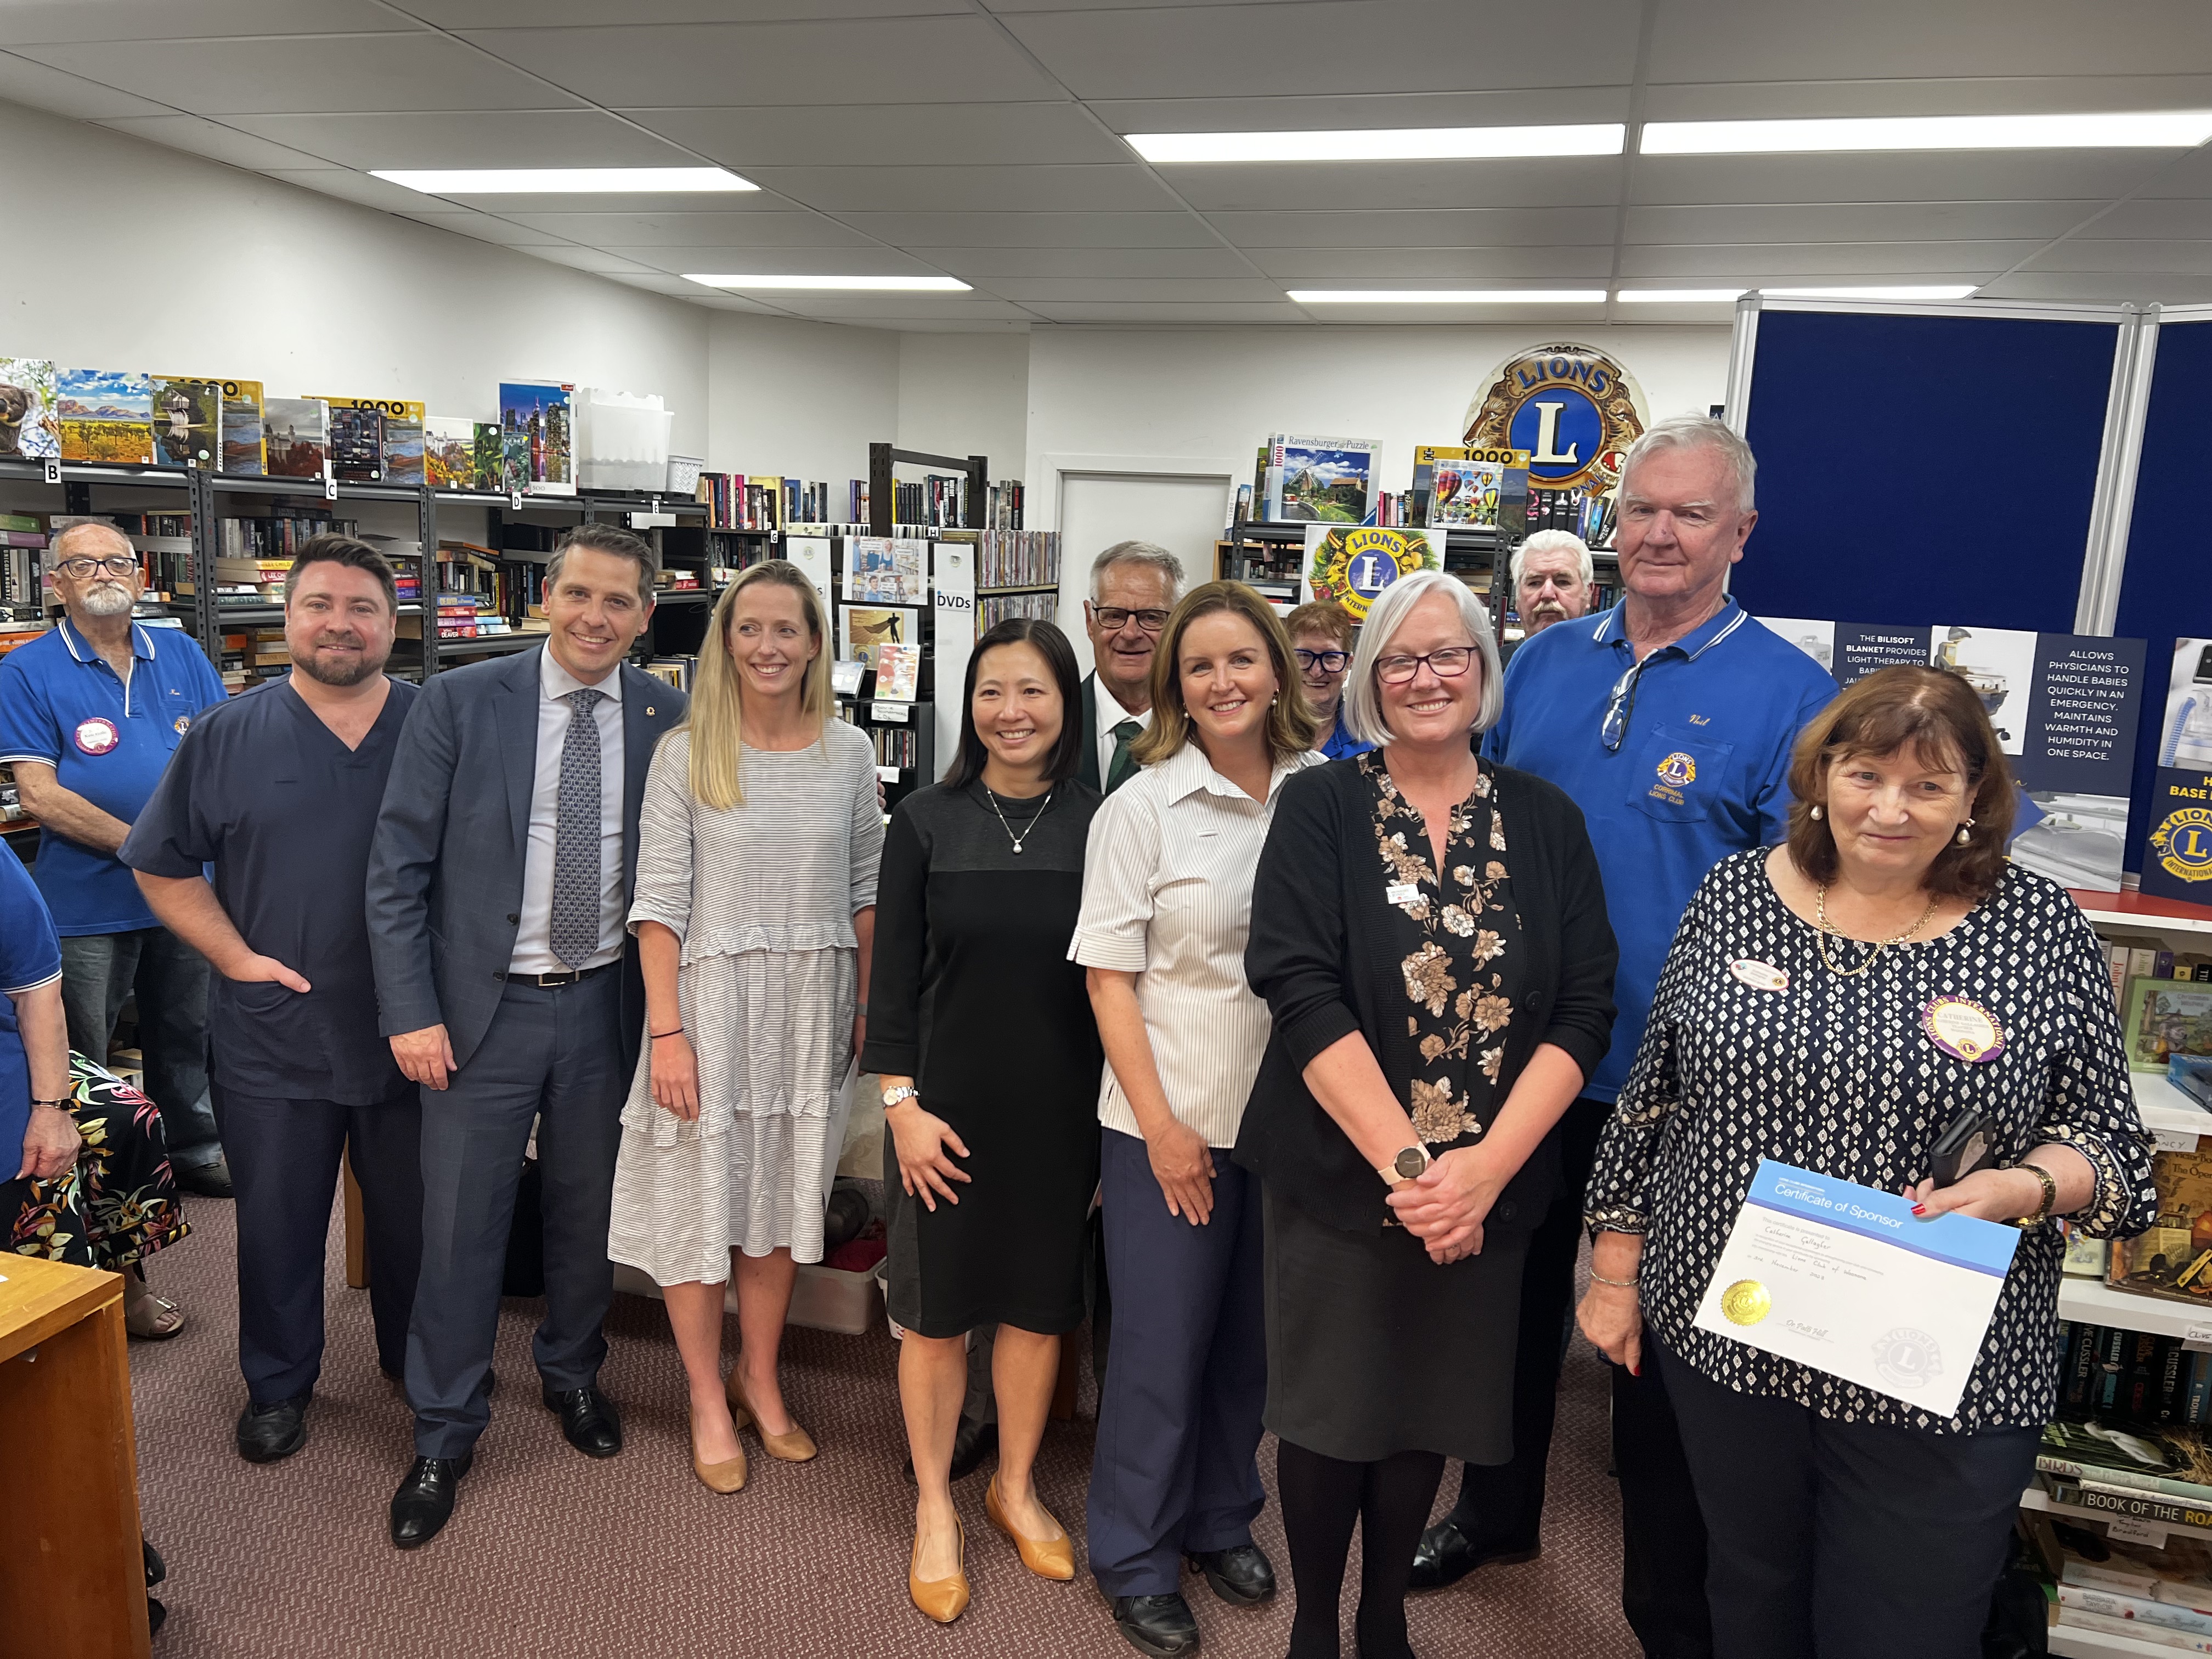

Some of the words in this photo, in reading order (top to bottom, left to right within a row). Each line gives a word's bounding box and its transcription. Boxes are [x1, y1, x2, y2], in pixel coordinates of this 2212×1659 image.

[1516, 357, 1610, 391] LIONS
[352, 399, 404, 415] 1000
[1531, 402, 1578, 464] L
[1289, 436, 1338, 449] Ravensburger
[1346, 440, 1369, 449] Puzzle
[1274, 445, 1284, 467] 1000
[1464, 449, 1513, 464] 1000
[48, 465, 58, 479] B
[329, 484, 335, 496] C
[514, 496, 520, 507] D
[654, 504, 658, 514] E
[772, 533, 777, 541] G
[1351, 532, 1402, 552] LIONS
[1359, 556, 1386, 591] L
[937, 595, 971, 608] DVDs
[1860, 634, 1876, 642] THE
[1877, 636, 1915, 645] BILISOFT
[1846, 645, 1884, 653] BLANKET
[1885, 647, 1927, 656] PROVIDES
[2069, 650, 2114, 661] ALLOWS
[1872, 657, 1911, 665] THERAPY
[2049, 661, 2112, 673] PHYSICIANS
[2114, 665, 2129, 674] TO
[2047, 674, 2089, 684] HANDLE
[2091, 676, 2128, 687] BABIES
[2047, 686, 2095, 697] QUICKLY
[2109, 691, 2124, 699] AN
[2050, 698, 2119, 711] EMERGENCY.
[1689, 714, 1711, 726] Neil
[2054, 712, 2112, 723] MAINTAINS
[2045, 723, 2093, 734] WARMTH
[2095, 727, 2119, 736] AND
[2047, 736, 2099, 747] HUMIDITY
[2101, 740, 2112, 748] IN
[1672, 753, 1692, 765] LIONS
[2047, 748, 2070, 757] ONE
[2072, 749, 2110, 760] SPACE.
[1669, 761, 1682, 777] L
[1649, 789, 1666, 800] LIONS
[1668, 796, 1685, 805] CLUB
[2169, 785, 2208, 799] BASE
[2174, 810, 2212, 823] LION
[2184, 830, 2208, 857] L
[2167, 860, 2212, 878] INTERNATIONA
[2138, 952, 2150, 971] John
[2111, 961, 2124, 983] John
[1926, 996, 1950, 1014] CLUBS
[1937, 1012, 1984, 1024] CATHERINE
[1954, 996, 2004, 1049] INTERNATIONAL
[1925, 1016, 1942, 1041] LIONS
[1965, 1044, 1974, 1054] L
[2175, 1152, 2198, 1161] Victor
[2199, 1153, 2212, 1164] Bo
[2172, 1163, 2188, 1173] The
[2189, 1166, 2212, 1179] Oper
[1775, 1183, 1832, 1209] Certificate
[1835, 1202, 1848, 1212] of
[1849, 1205, 1904, 1229] Sponsor
[1772, 1219, 1795, 1231] certificate
[1800, 1227, 1825, 1240] presented
[1765, 1226, 1791, 1239] Catherine
[1801, 1235, 1831, 1250] Gallagher
[1771, 1259, 1798, 1273] November
[1792, 1254, 1806, 1263] Lions
[1813, 1260, 1826, 1269] Club
[1786, 1319, 1796, 1327] Dr.
[1796, 1323, 1813, 1332] Patti
[1812, 1328, 1829, 1337] Hill
[1894, 1330, 1936, 1350] LIONS
[2110, 1331, 2123, 1362] CUSSLER
[1897, 1345, 1916, 1370] L
[2077, 1338, 2093, 1378] CUSSLER
[2162, 1351, 2180, 1393] CUSSLER
[2190, 1395, 2201, 1420] TROJAN
[2038, 1457, 2083, 1476] BIRDS
[2087, 1493, 2126, 1512] BOOK
[2131, 1500, 2150, 1515] OF
[2153, 1504, 2180, 1521] THE
[2185, 1510, 2212, 1526] ROA
[2083, 1592, 2117, 1605] BARBARA
